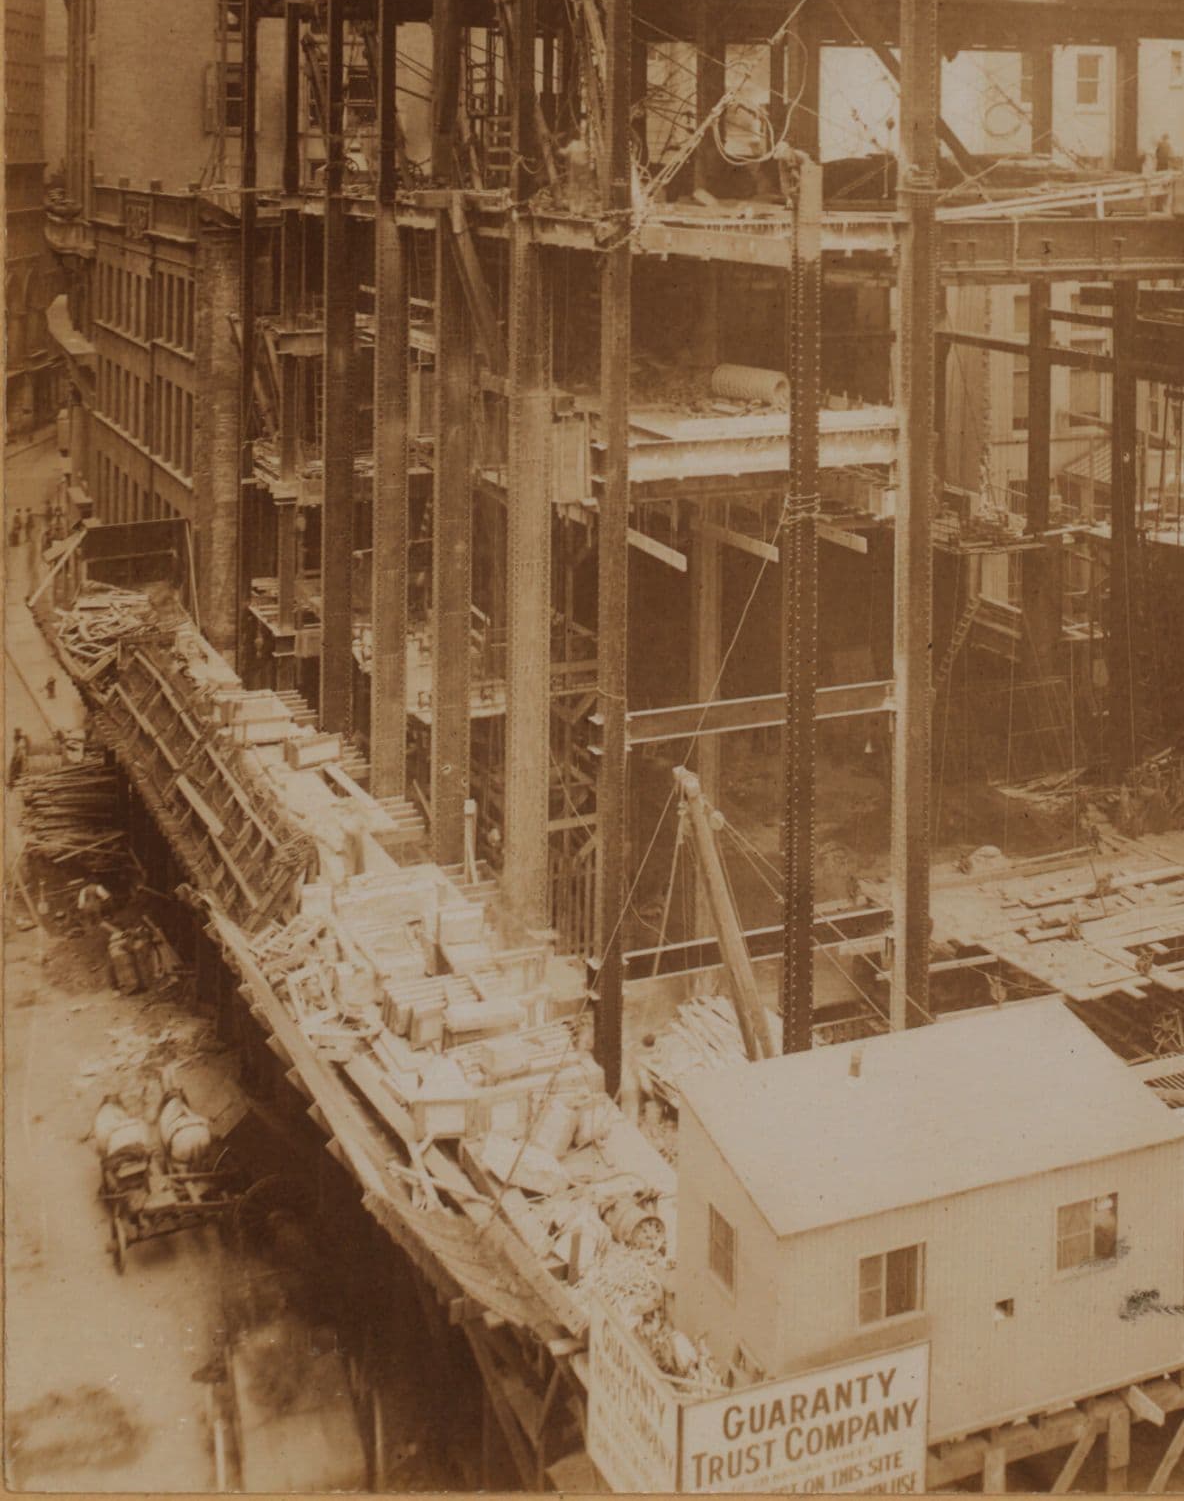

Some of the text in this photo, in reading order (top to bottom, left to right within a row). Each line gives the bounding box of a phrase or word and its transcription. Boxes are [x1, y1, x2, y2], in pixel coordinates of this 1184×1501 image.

[723, 1367, 897, 1441] GUARANTY
[692, 1439, 776, 1488] TRUST
[785, 1398, 920, 1462] COMPANY
[832, 1464, 863, 1488] THIS
[868, 1450, 904, 1477] SITE
